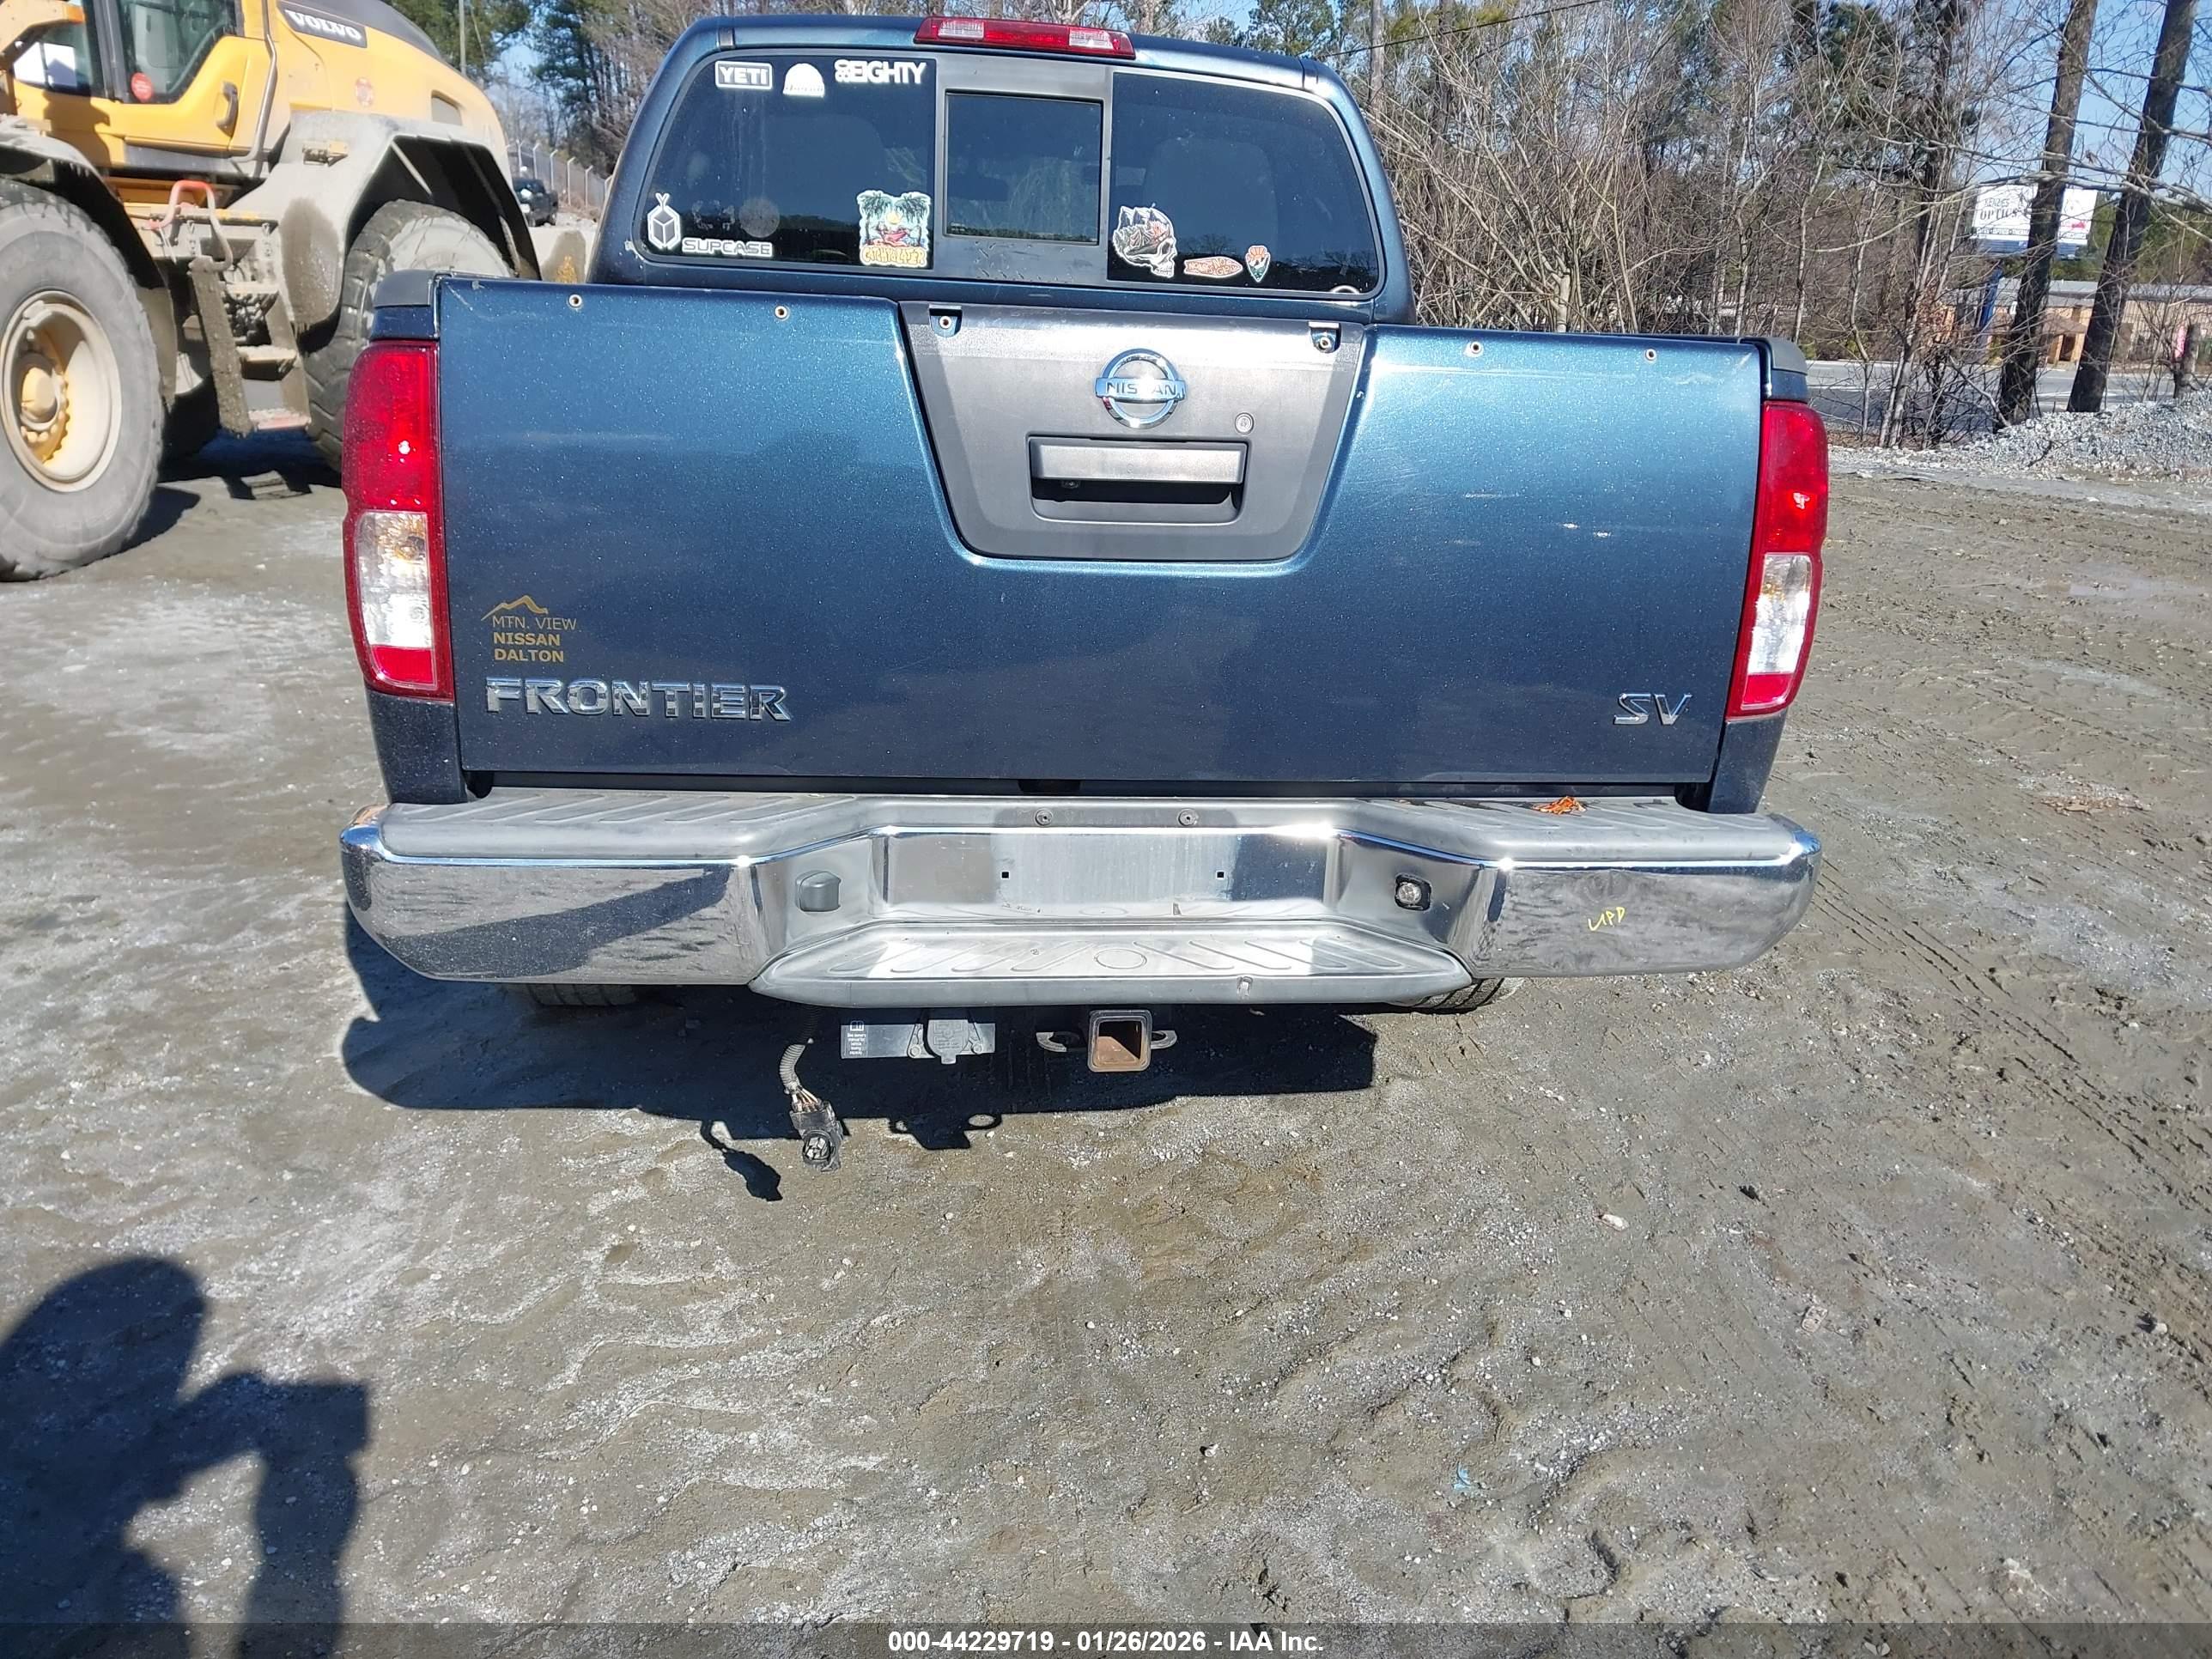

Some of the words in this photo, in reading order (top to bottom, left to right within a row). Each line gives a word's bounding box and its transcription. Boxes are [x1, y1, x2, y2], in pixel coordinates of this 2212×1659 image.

[284, 9, 362, 40] VOLVO
[719, 66, 769, 85] YETI
[684, 239, 772, 256] SUPCASE
[1106, 381, 1177, 396] NISAN
[492, 616, 530, 629] MTN.
[535, 617, 577, 631] VIEW
[493, 631, 561, 647] NISSAN
[494, 648, 564, 663] DALTON
[485, 677, 791, 721] FRONTIER
[1613, 693, 1693, 726] SV
